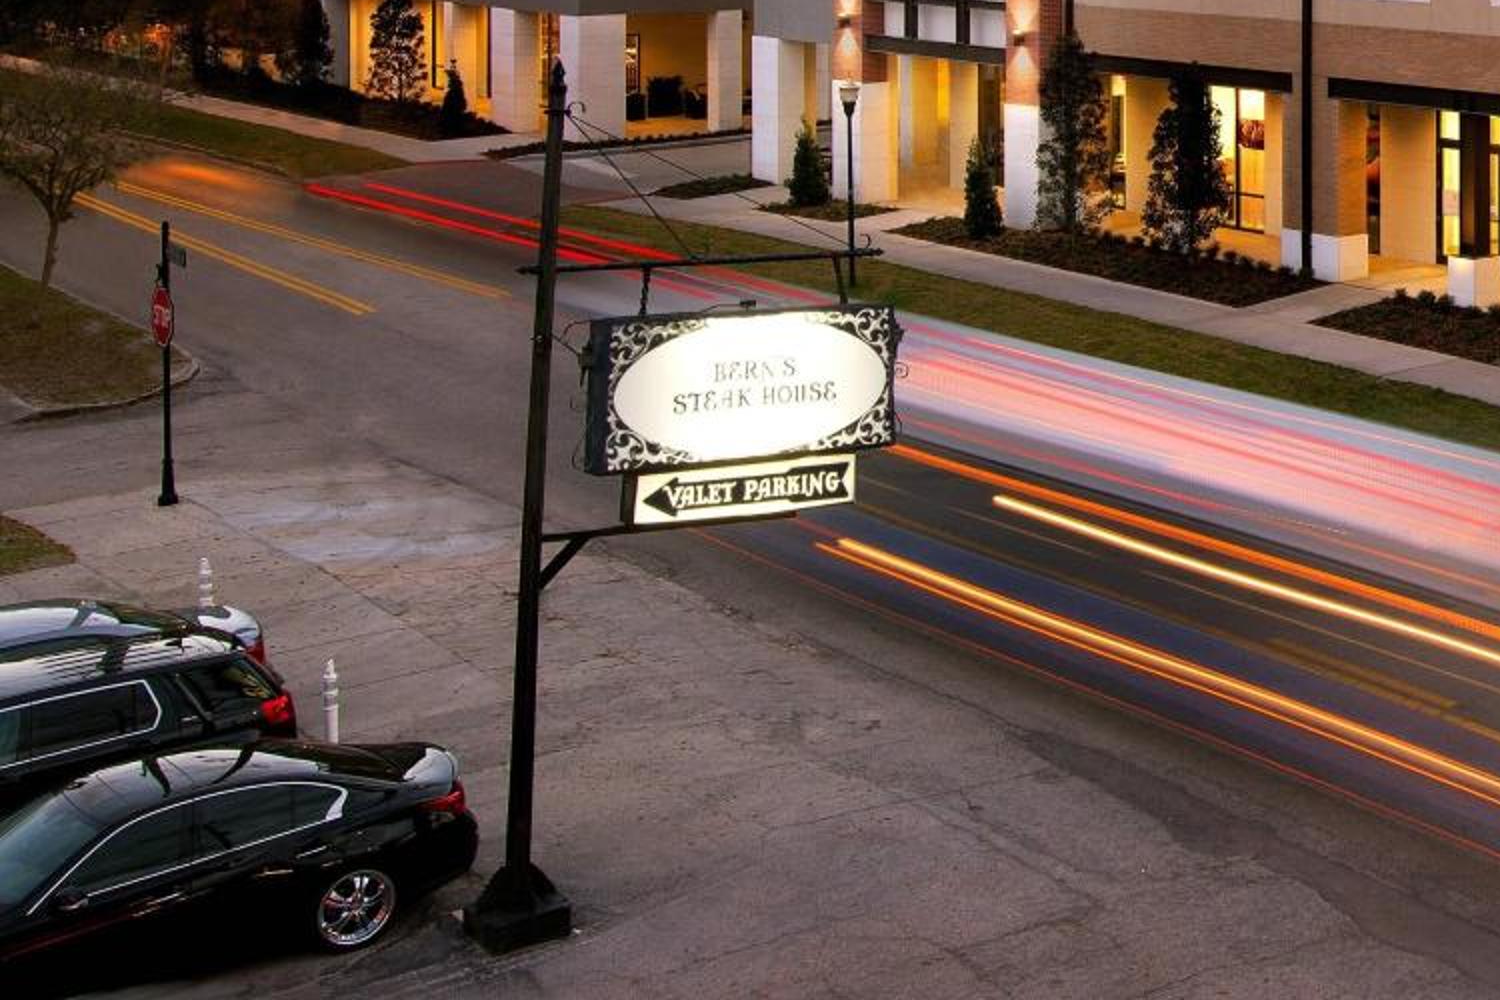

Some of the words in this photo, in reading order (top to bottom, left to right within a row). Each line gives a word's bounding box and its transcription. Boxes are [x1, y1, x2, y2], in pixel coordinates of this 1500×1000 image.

[714, 357, 796, 383] BERNS
[673, 388, 752, 415] STEAK
[763, 380, 837, 406] HOUSE
[663, 481, 737, 509] VALET
[743, 471, 840, 502] PARKING
